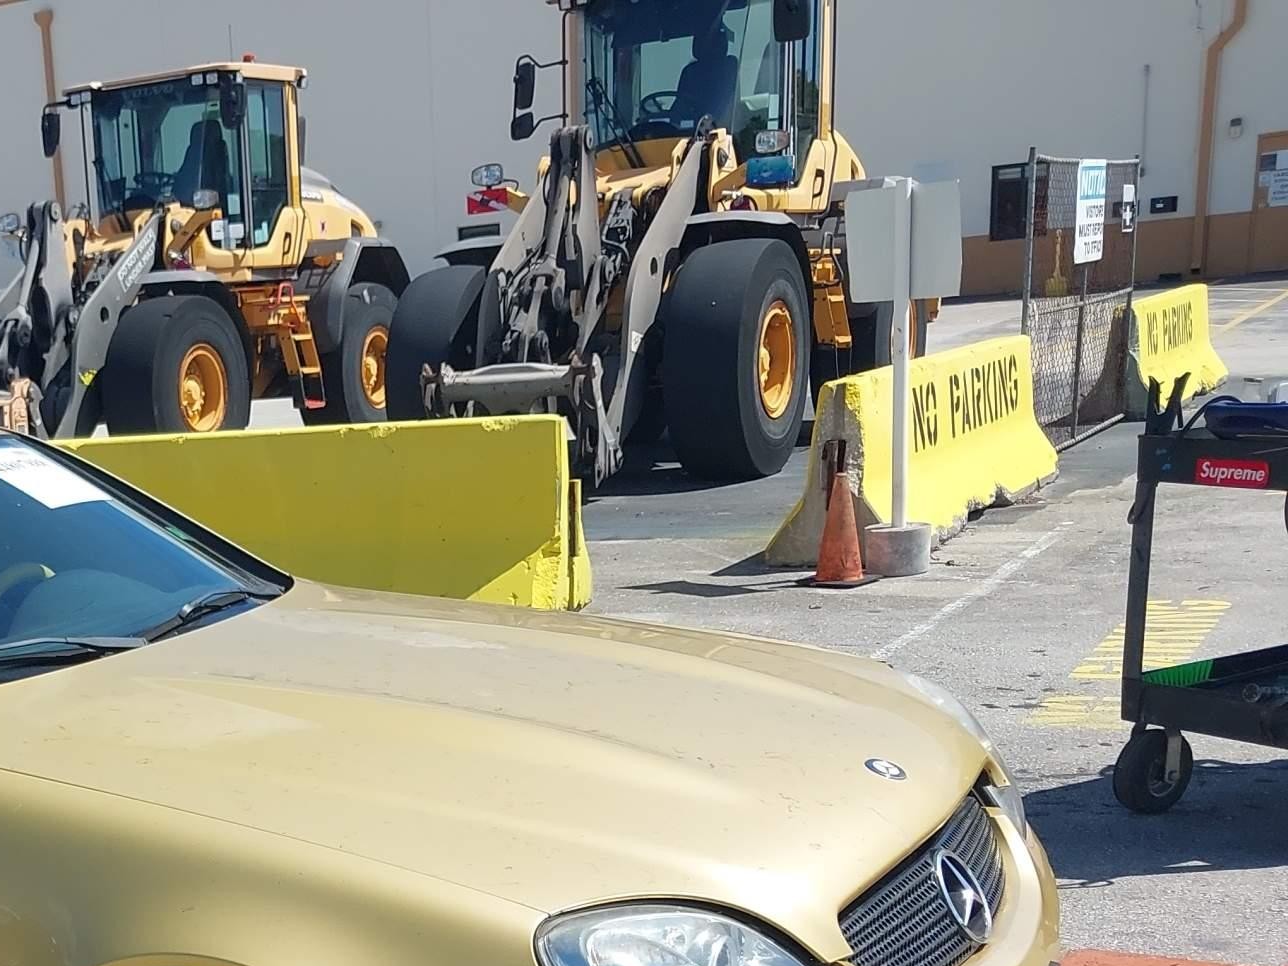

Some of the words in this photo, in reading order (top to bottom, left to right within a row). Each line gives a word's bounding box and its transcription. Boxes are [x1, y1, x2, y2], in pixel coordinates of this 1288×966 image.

[1080, 170, 1105, 196] NOTIC
[1146, 311, 1158, 356] NO
[1162, 301, 1193, 352] PARKING
[912, 381, 938, 453] NO
[949, 354, 1019, 439] PARKING
[1200, 461, 1265, 484] Supreme
